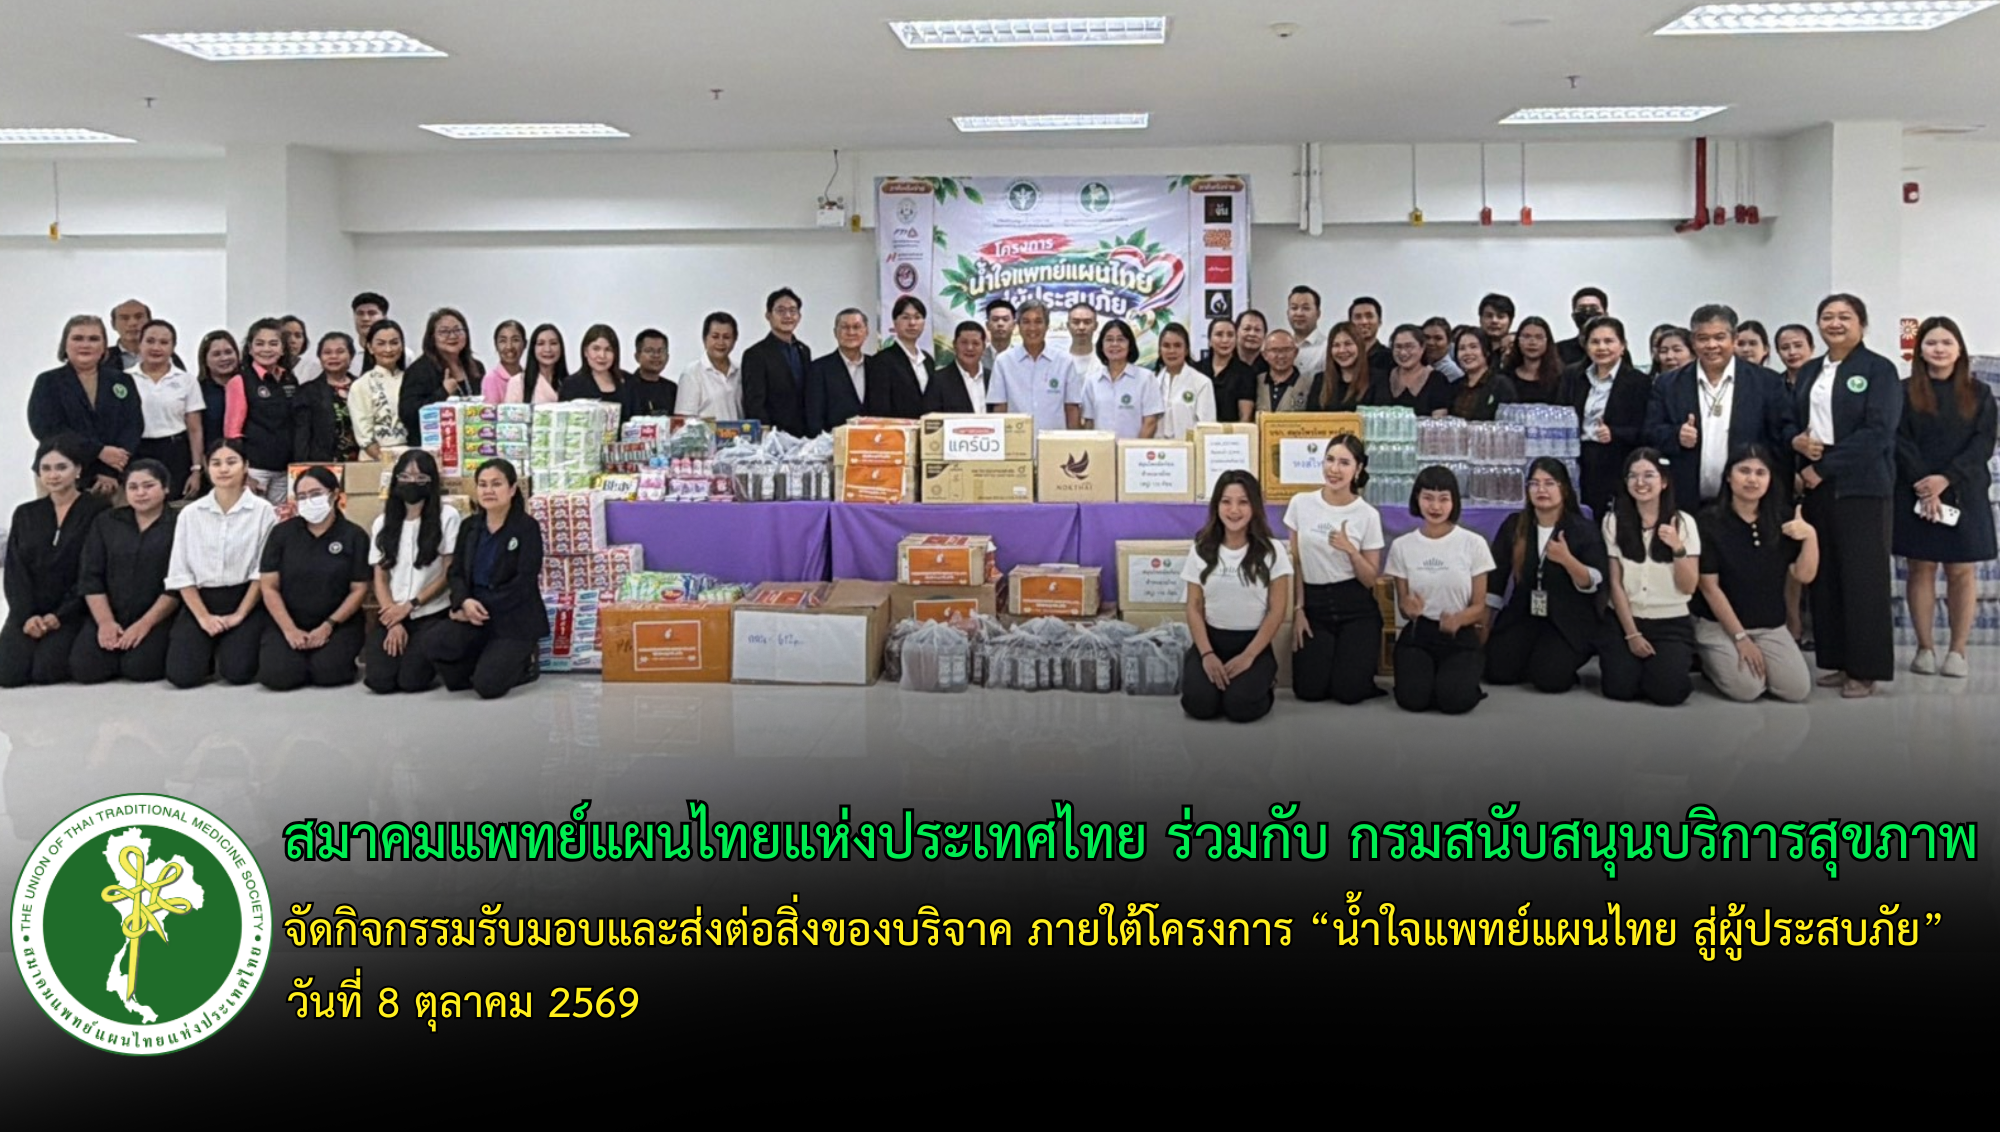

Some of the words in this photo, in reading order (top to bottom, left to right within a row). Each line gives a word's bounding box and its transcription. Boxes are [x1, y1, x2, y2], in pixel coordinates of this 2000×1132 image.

[994, 239, 1054, 258] โครงการ
[968, 261, 1154, 297] น้ำใจแพทย์แผนไทย
[948, 435, 1001, 452] แคร์บิว
